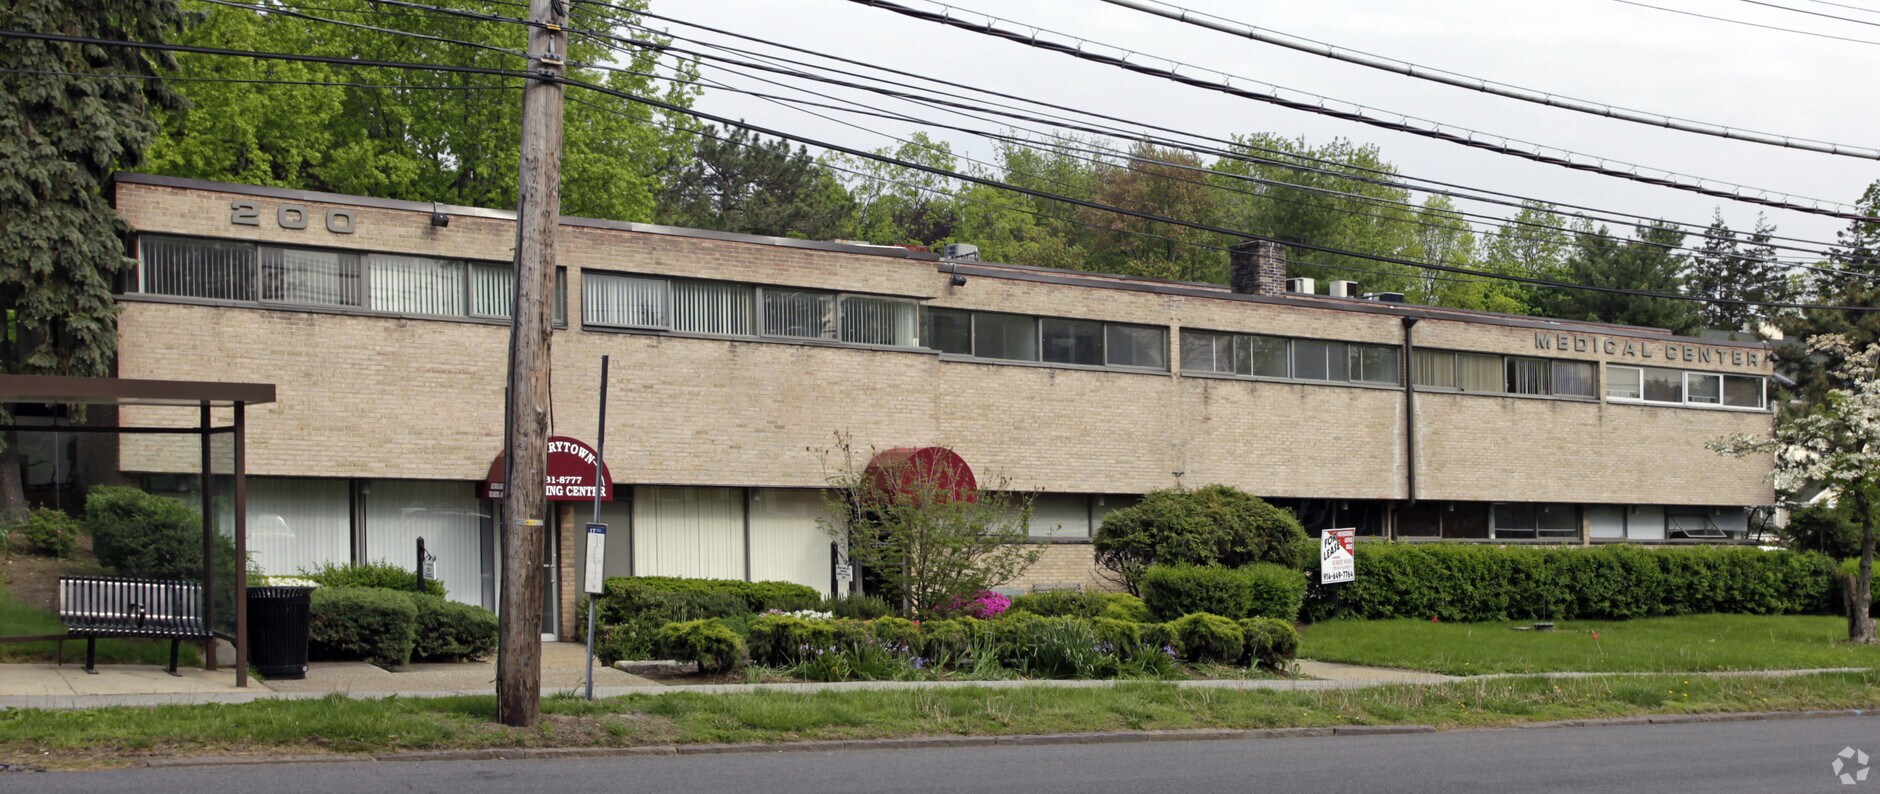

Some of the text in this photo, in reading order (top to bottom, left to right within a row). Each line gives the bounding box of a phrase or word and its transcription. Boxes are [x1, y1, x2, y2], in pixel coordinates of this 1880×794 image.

[231, 200, 356, 234] 200
[1534, 331, 1759, 367] MEDICAL CENTER
[548, 441, 596, 465] RYTOWN
[546, 476, 582, 484] 31-8777
[546, 485, 564, 496] ING
[1324, 532, 1337, 548] FOR
[1323, 541, 1340, 561] LEASE
